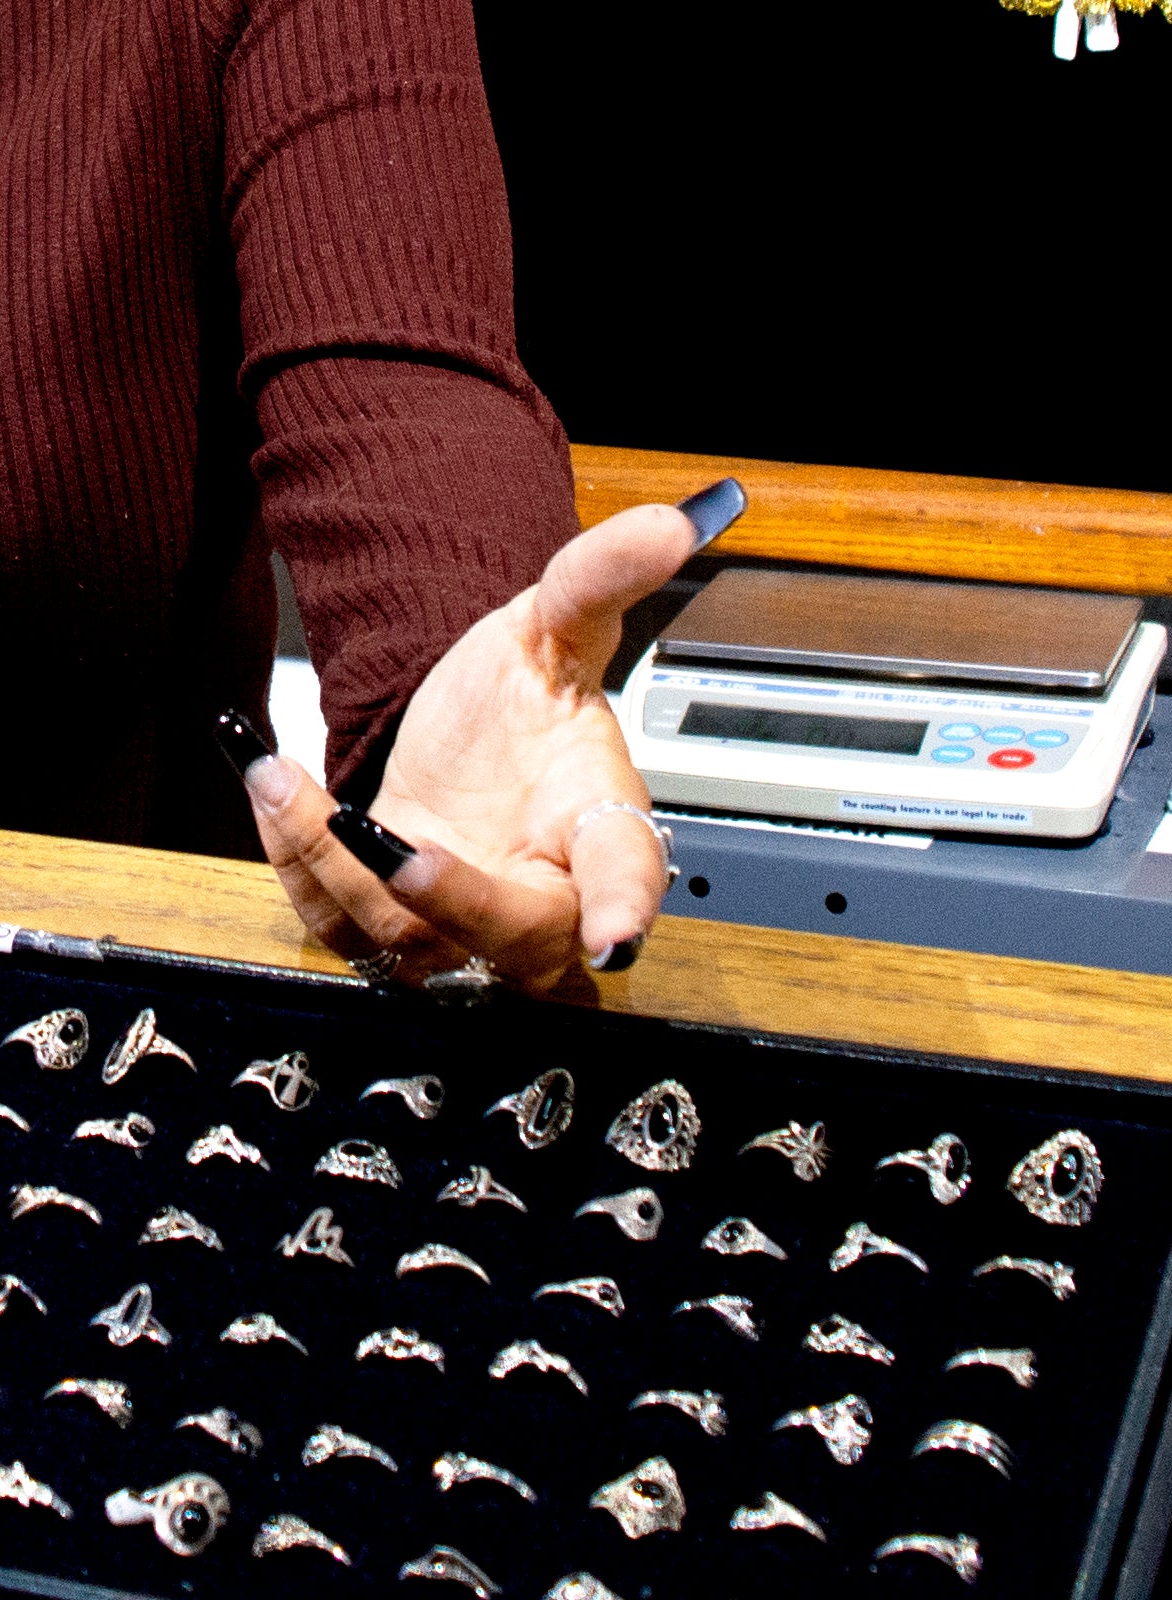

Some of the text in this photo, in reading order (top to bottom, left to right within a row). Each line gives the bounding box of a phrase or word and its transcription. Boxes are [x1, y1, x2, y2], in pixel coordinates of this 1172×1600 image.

[843, 800, 858, 809] The
[860, 802, 897, 814] counting
[900, 803, 931, 815] feature
[944, 808, 959, 816] not
[961, 809, 984, 820] legal
[986, 811, 999, 819] for
